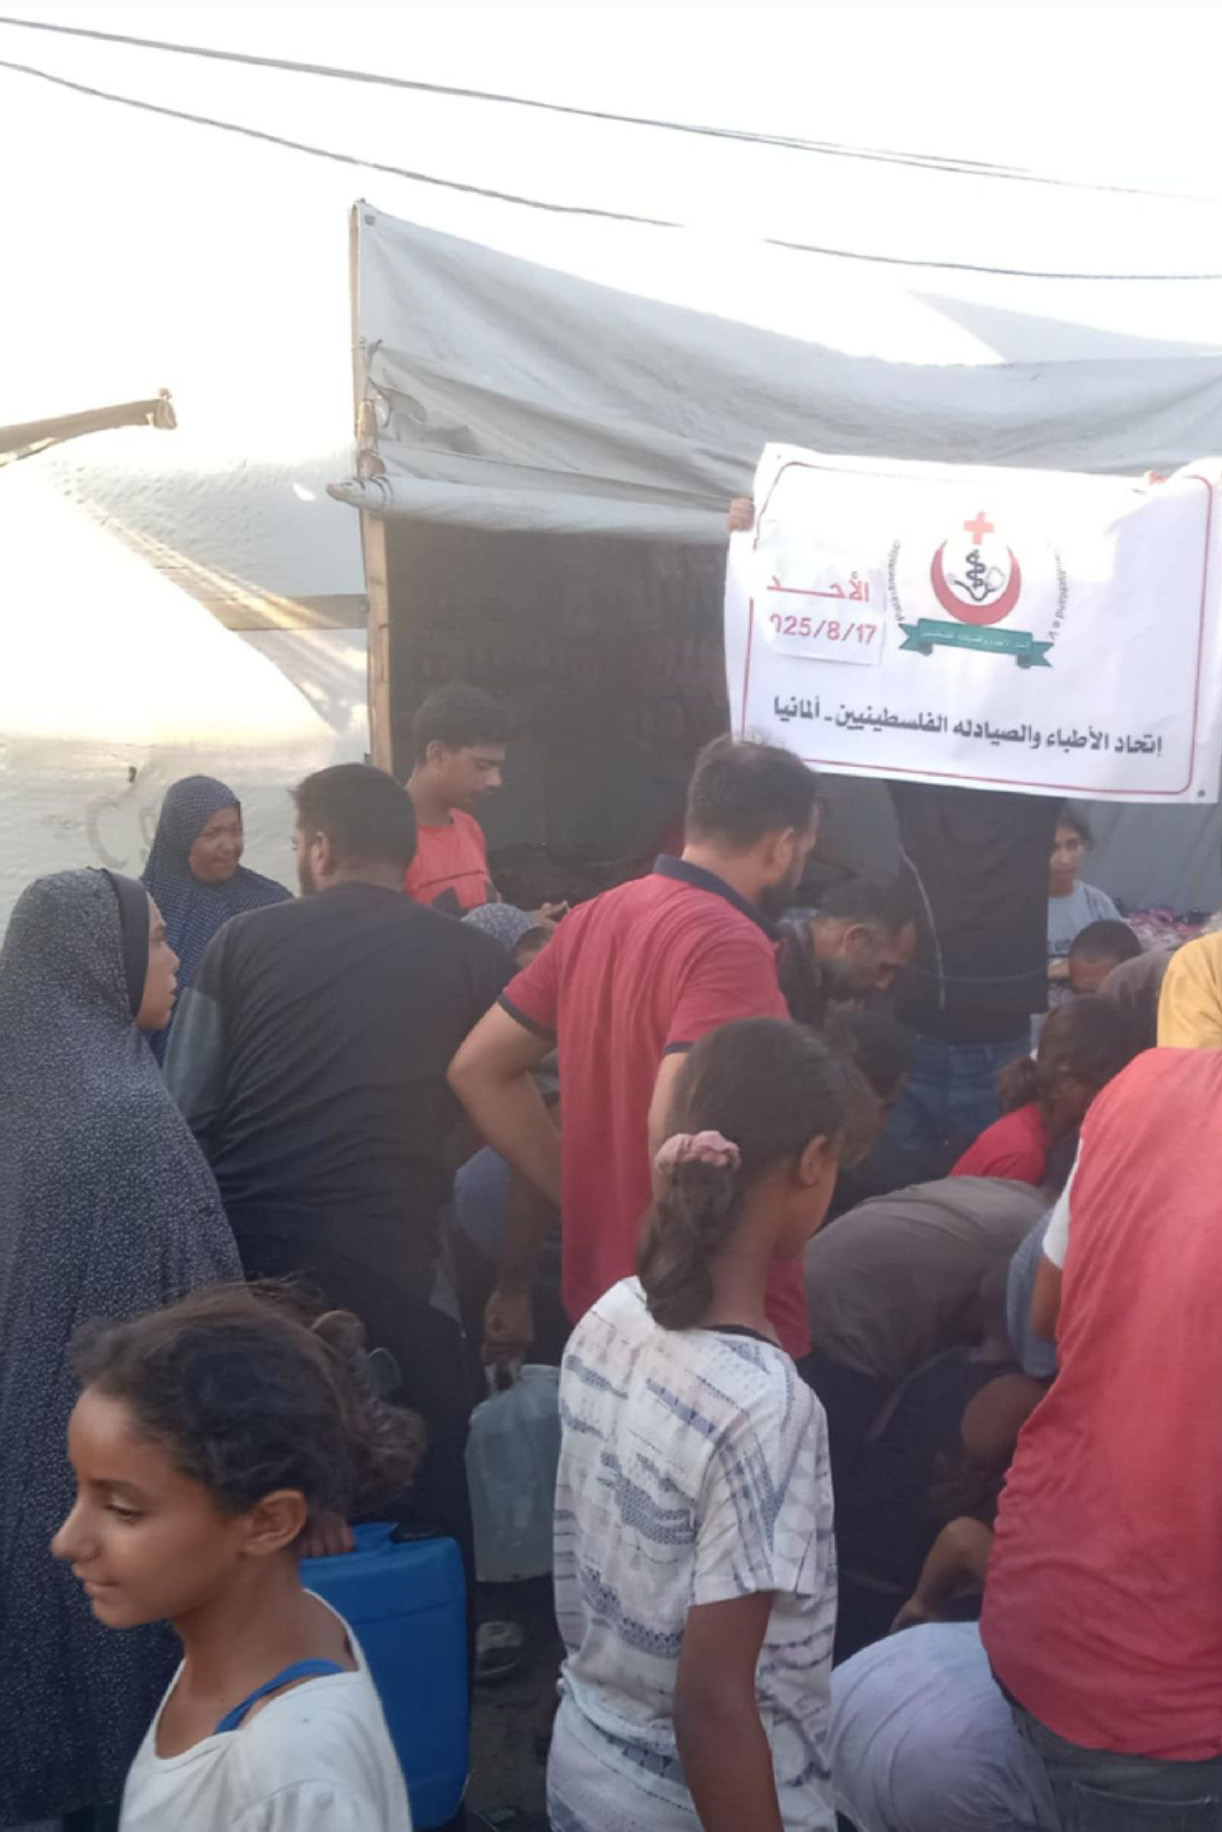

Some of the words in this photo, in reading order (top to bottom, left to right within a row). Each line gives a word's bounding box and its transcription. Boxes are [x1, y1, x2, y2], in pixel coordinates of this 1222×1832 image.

[774, 695, 820, 722] ألمانيا
[835, 704, 948, 735] الفلسطينيين
[1046, 725, 1109, 753] الأطباء
[1114, 734, 1162, 757] إتحاد
